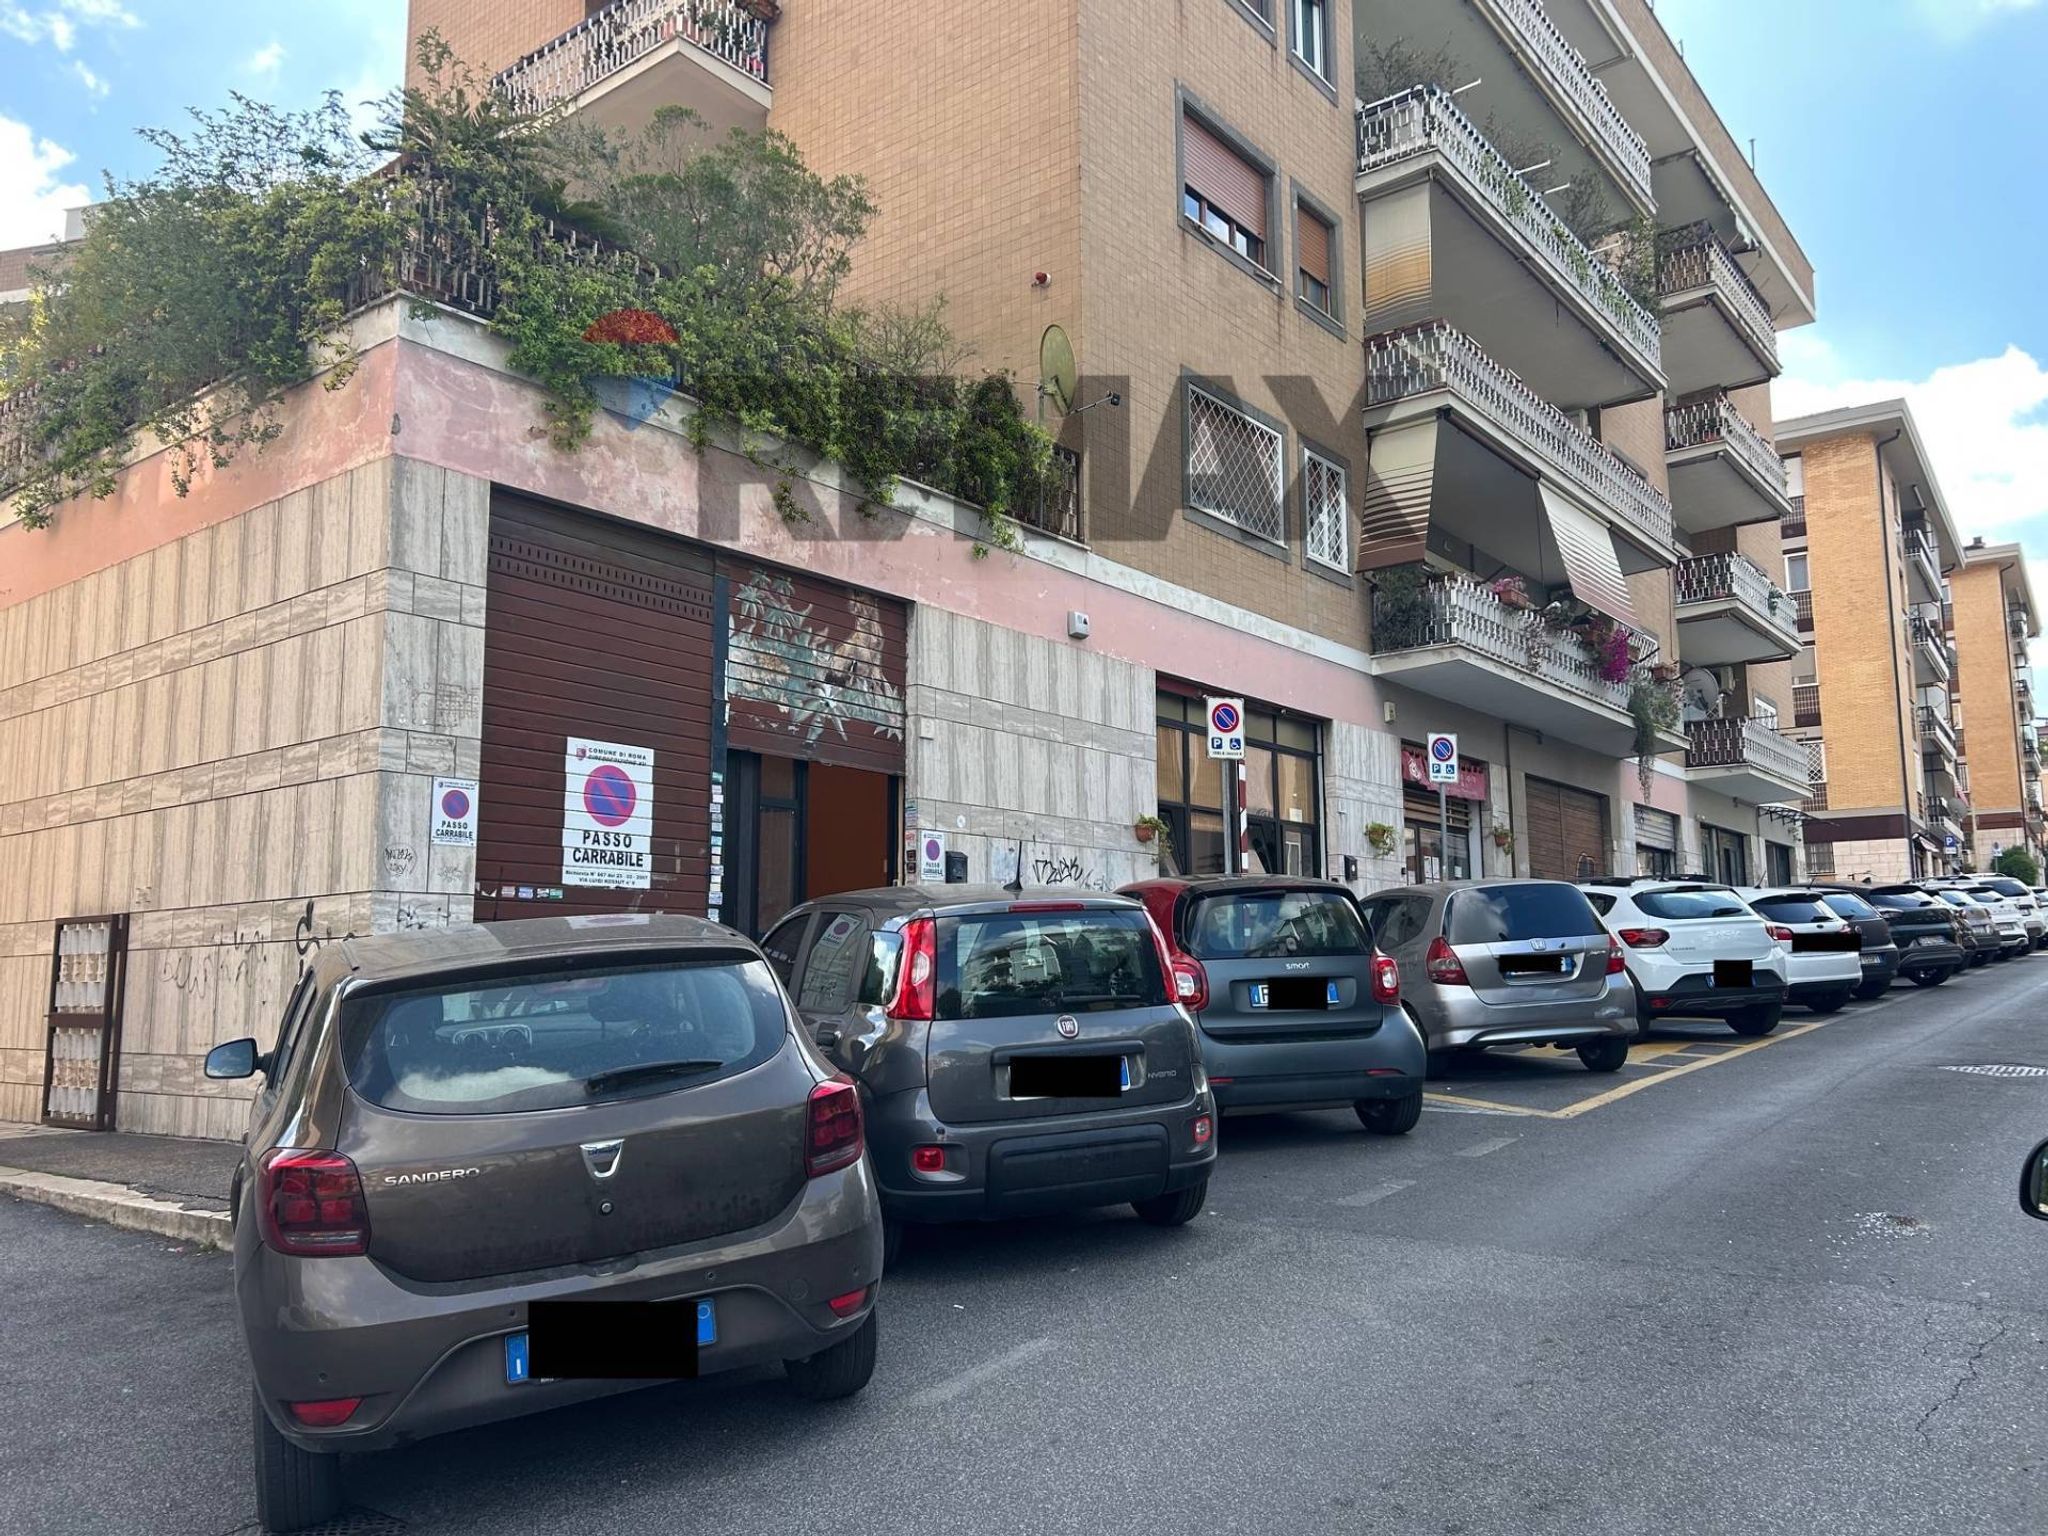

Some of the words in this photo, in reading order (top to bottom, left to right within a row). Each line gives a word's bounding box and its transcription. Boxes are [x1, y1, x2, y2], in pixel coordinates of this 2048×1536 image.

[442, 820, 468, 829] PASSO
[435, 829, 473, 839] CARRABILE
[582, 830, 632, 848] PASSO
[572, 848, 644, 867] CARRABILE
[1286, 962, 1310, 970] smart
[1061, 1020, 1074, 1031] FIAT
[384, 1167, 480, 1186] SANDERO
